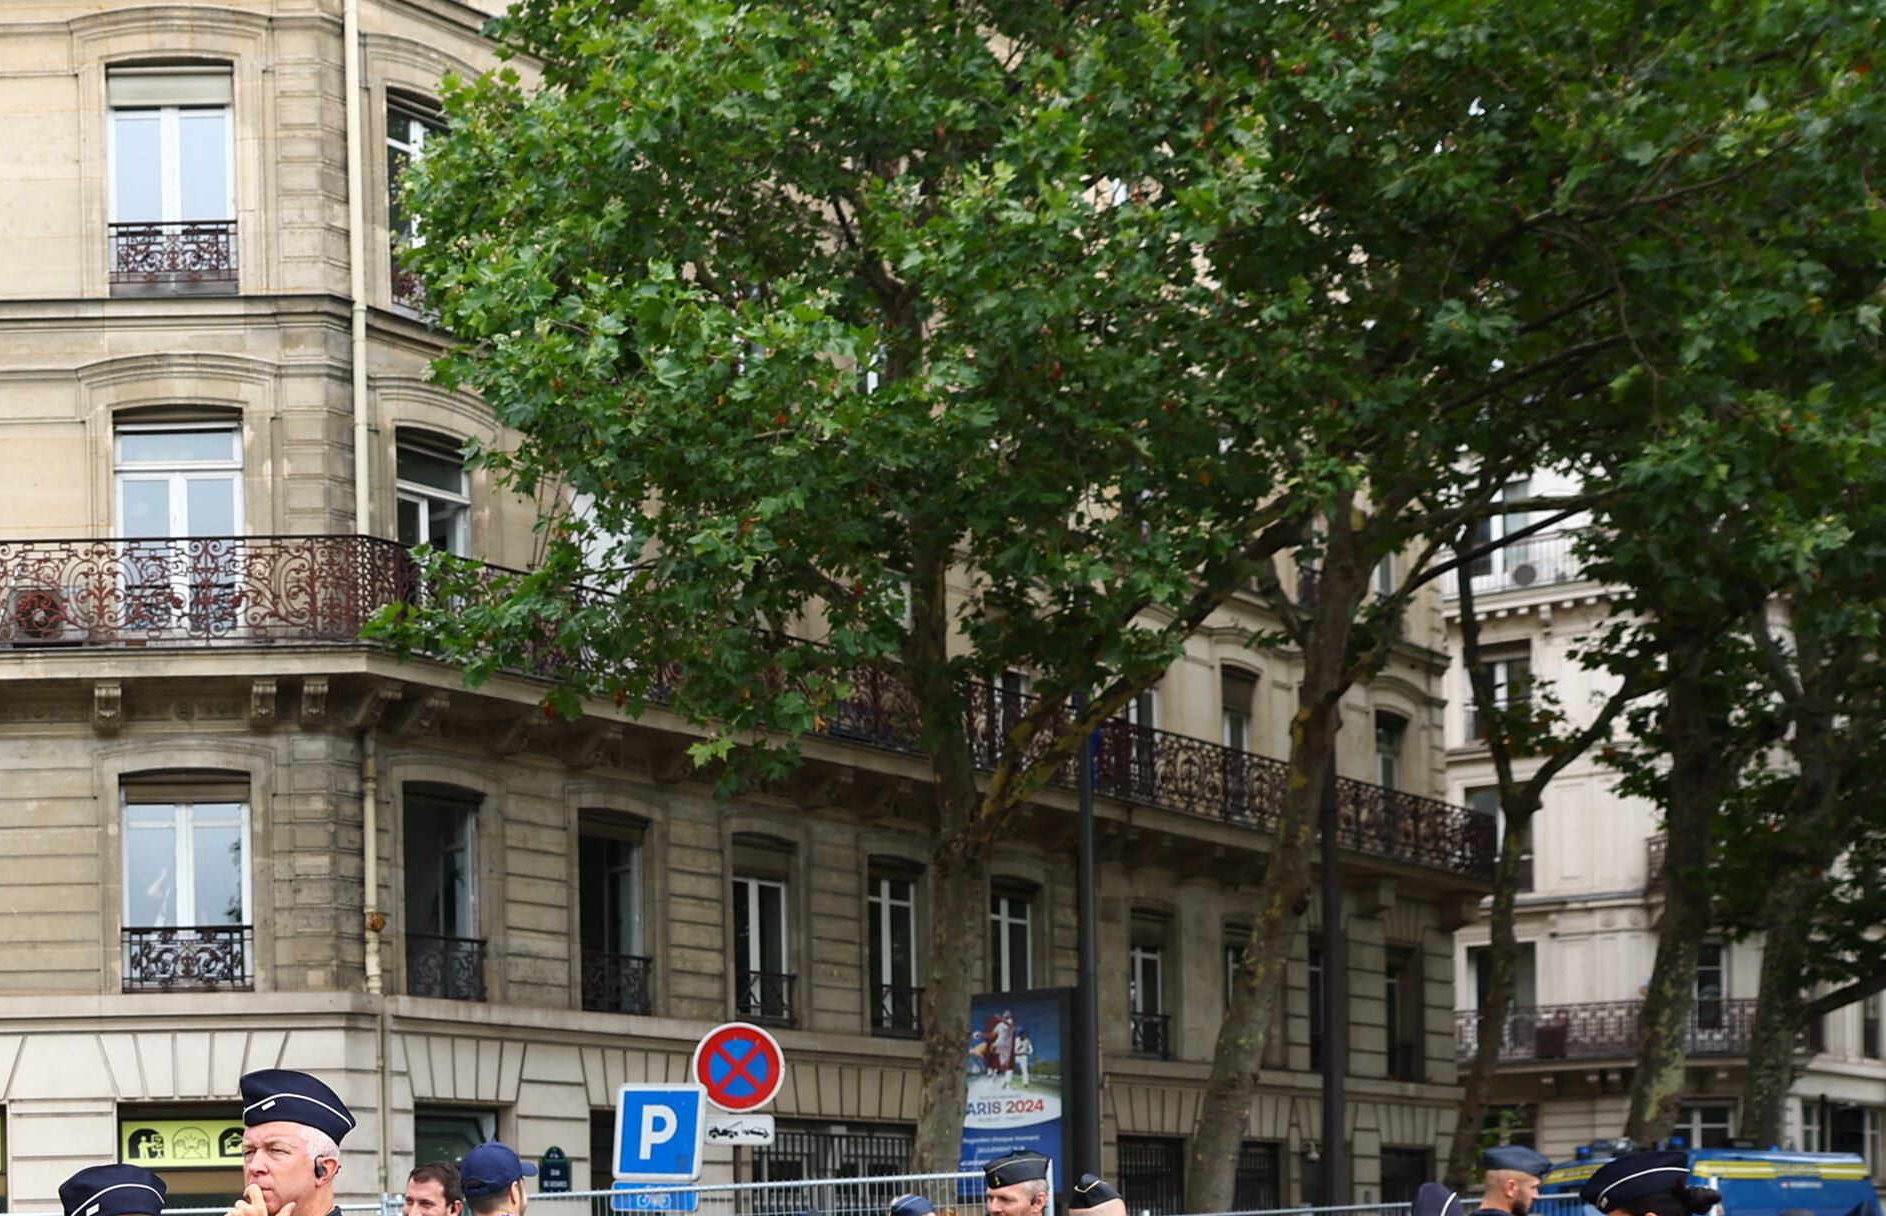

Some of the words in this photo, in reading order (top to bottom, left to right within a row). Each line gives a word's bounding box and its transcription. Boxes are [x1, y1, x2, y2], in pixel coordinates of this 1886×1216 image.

[966, 1101, 1001, 1115] ARIS
[1006, 1099, 1044, 1113] 2024
[639, 1104, 678, 1160] P
